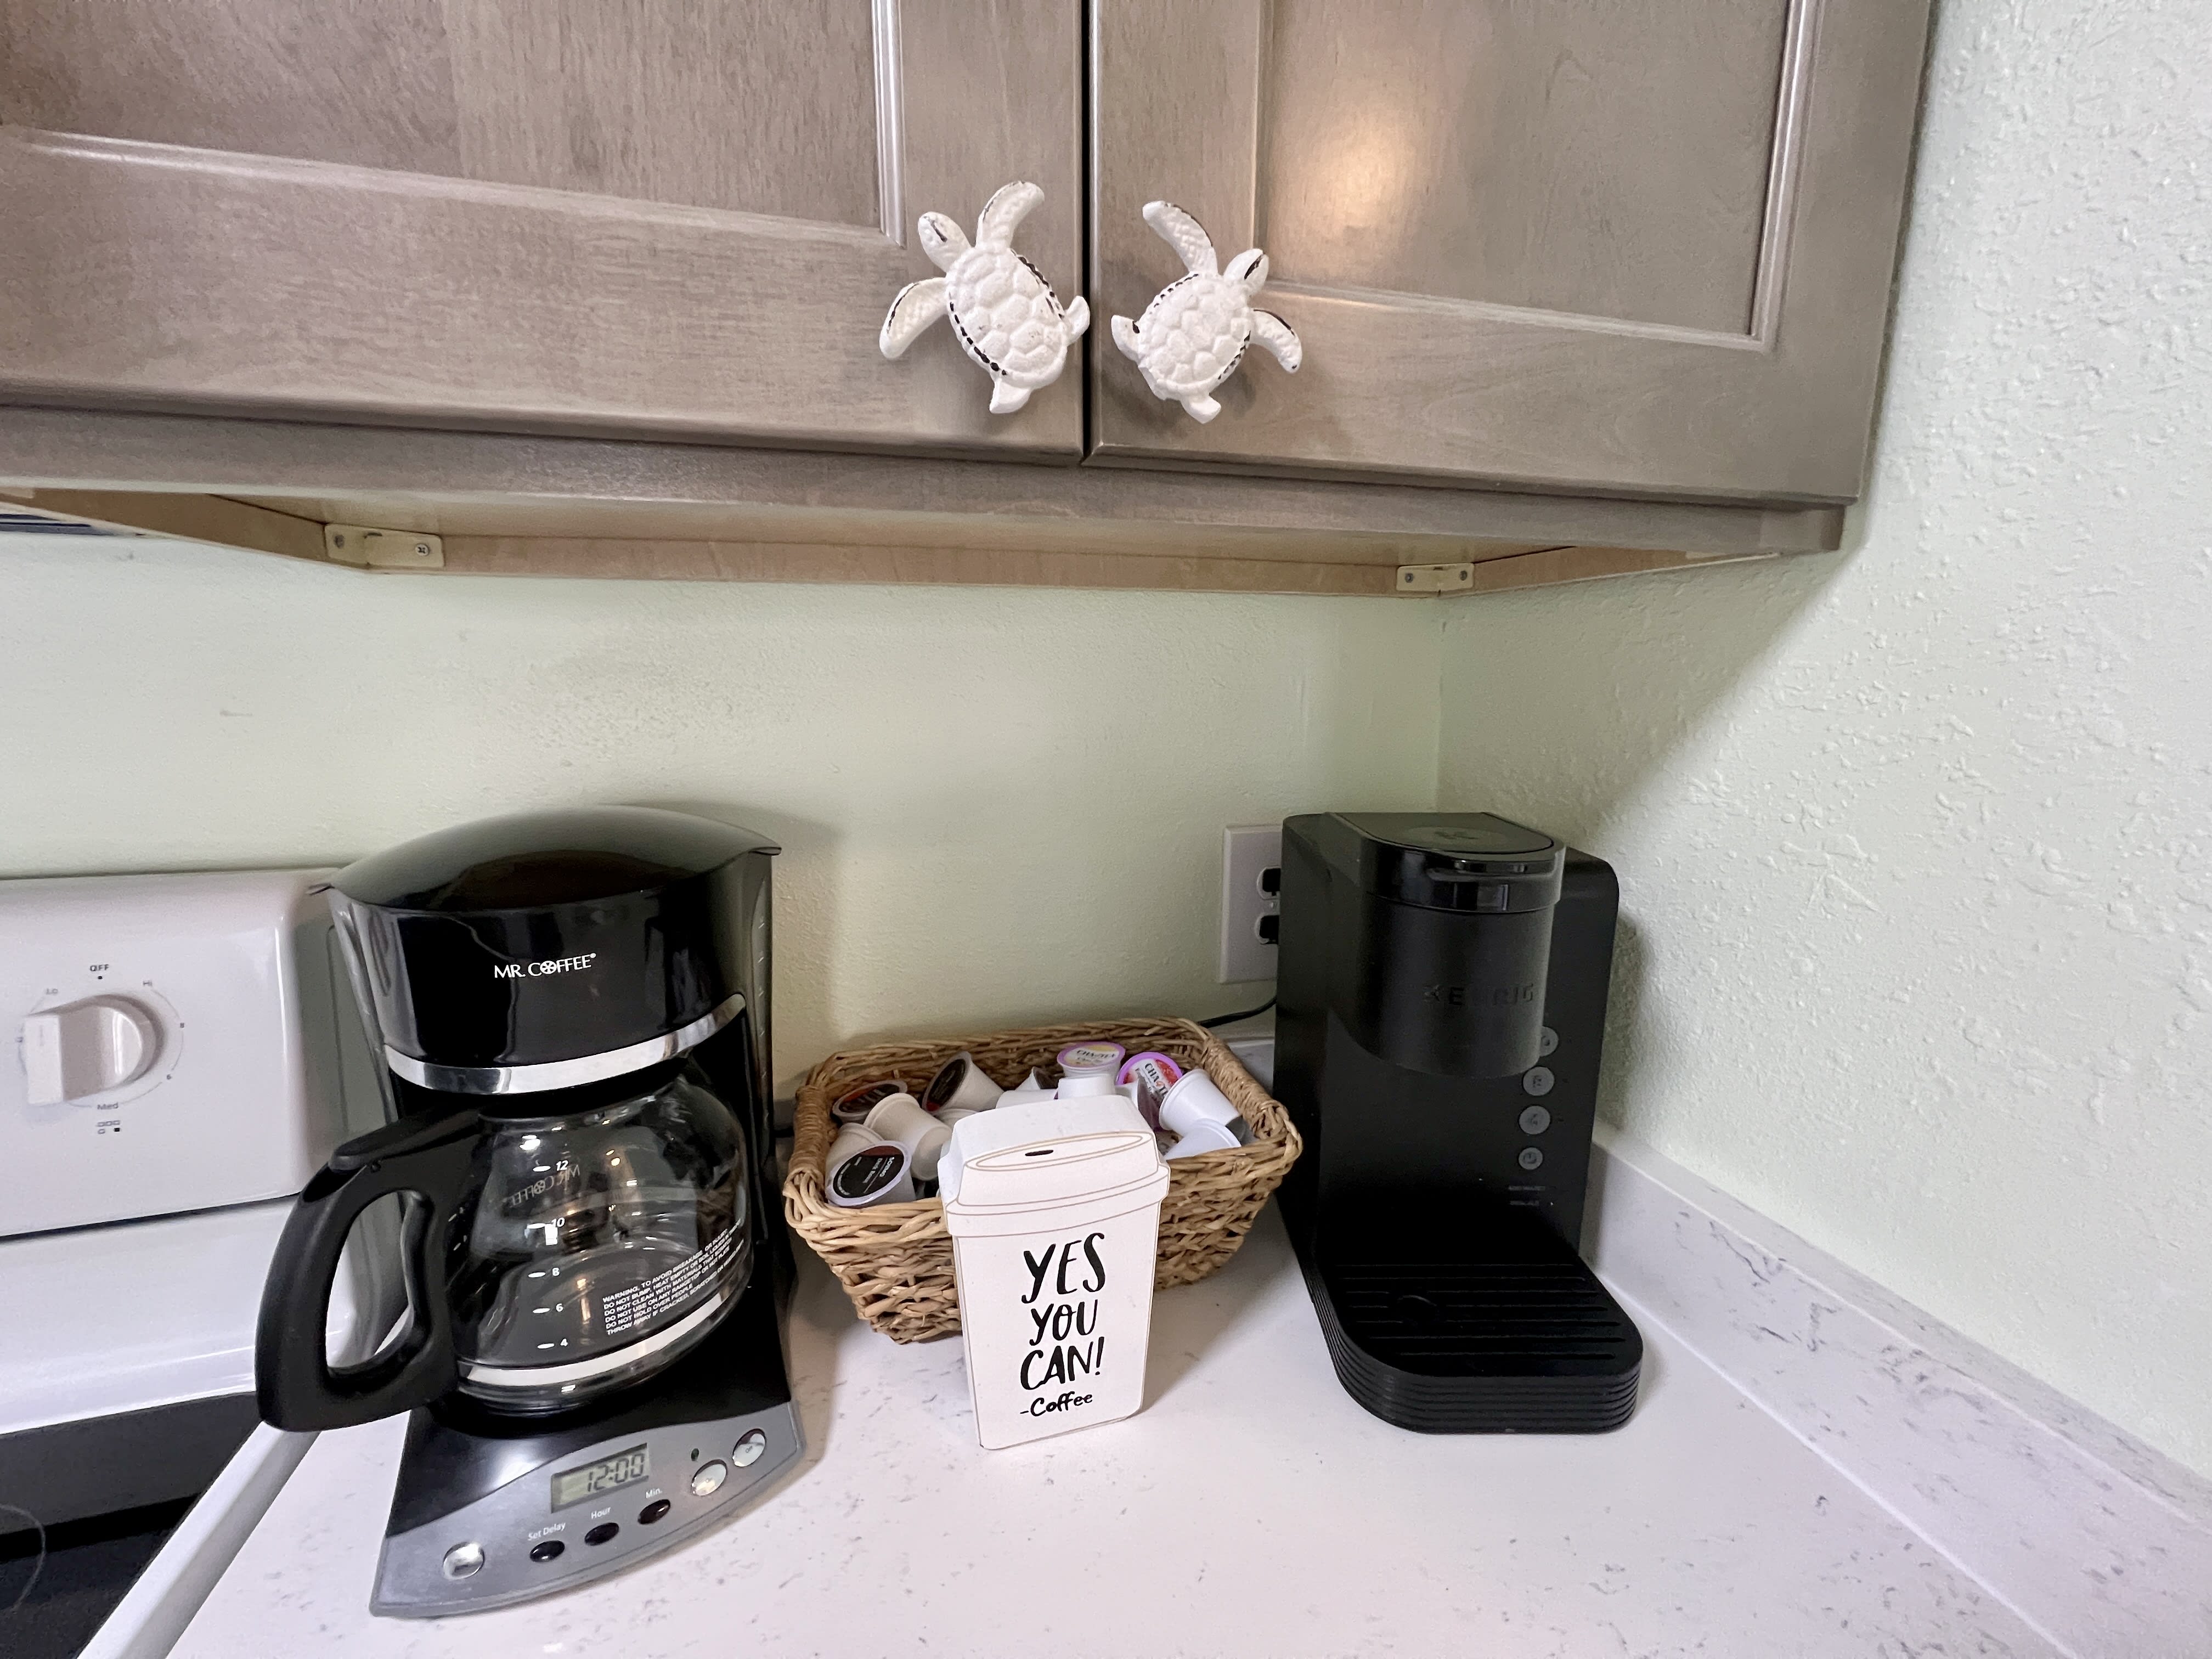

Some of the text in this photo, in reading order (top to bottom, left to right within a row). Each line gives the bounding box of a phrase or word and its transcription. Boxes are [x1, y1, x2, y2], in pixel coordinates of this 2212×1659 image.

[89, 964, 110, 972] OFF
[494, 964, 526, 978] MR.
[556, 1160, 568, 1171] 12
[551, 1217, 565, 1228] 10
[552, 1267, 560, 1277] 8
[652, 1270, 672, 1284] AVOID
[705, 1243, 712, 1251] OR
[1021, 1232, 1105, 1304] YES
[616, 1296, 630, 1305] NOT
[653, 1278, 669, 1290] HEAT
[690, 1260, 698, 1268] OR
[556, 1303, 563, 1312] 6
[617, 1302, 631, 1312] NOT
[632, 1292, 654, 1306] CLEAN
[656, 1283, 672, 1295] WITH
[617, 1308, 632, 1318] NOT
[633, 1302, 647, 1312] USE
[648, 1297, 658, 1305] ON
[658, 1290, 671, 1300] ANY
[606, 1321, 617, 1329] DO
[618, 1315, 633, 1324] NOT
[634, 1307, 652, 1318] HOLD
[653, 1297, 670, 1309] OVER
[1029, 1299, 1098, 1346] YOU
[607, 1322, 633, 1335] THROW
[634, 1313, 651, 1325] AWAY
[560, 1338, 568, 1346] 4
[1020, 1336, 1105, 1390] CAN!
[588, 1453, 645, 1492] 12:00
[645, 1488, 663, 1498] Min.
[591, 1507, 611, 1519] Hour
[527, 1522, 566, 1541] Set Delay
